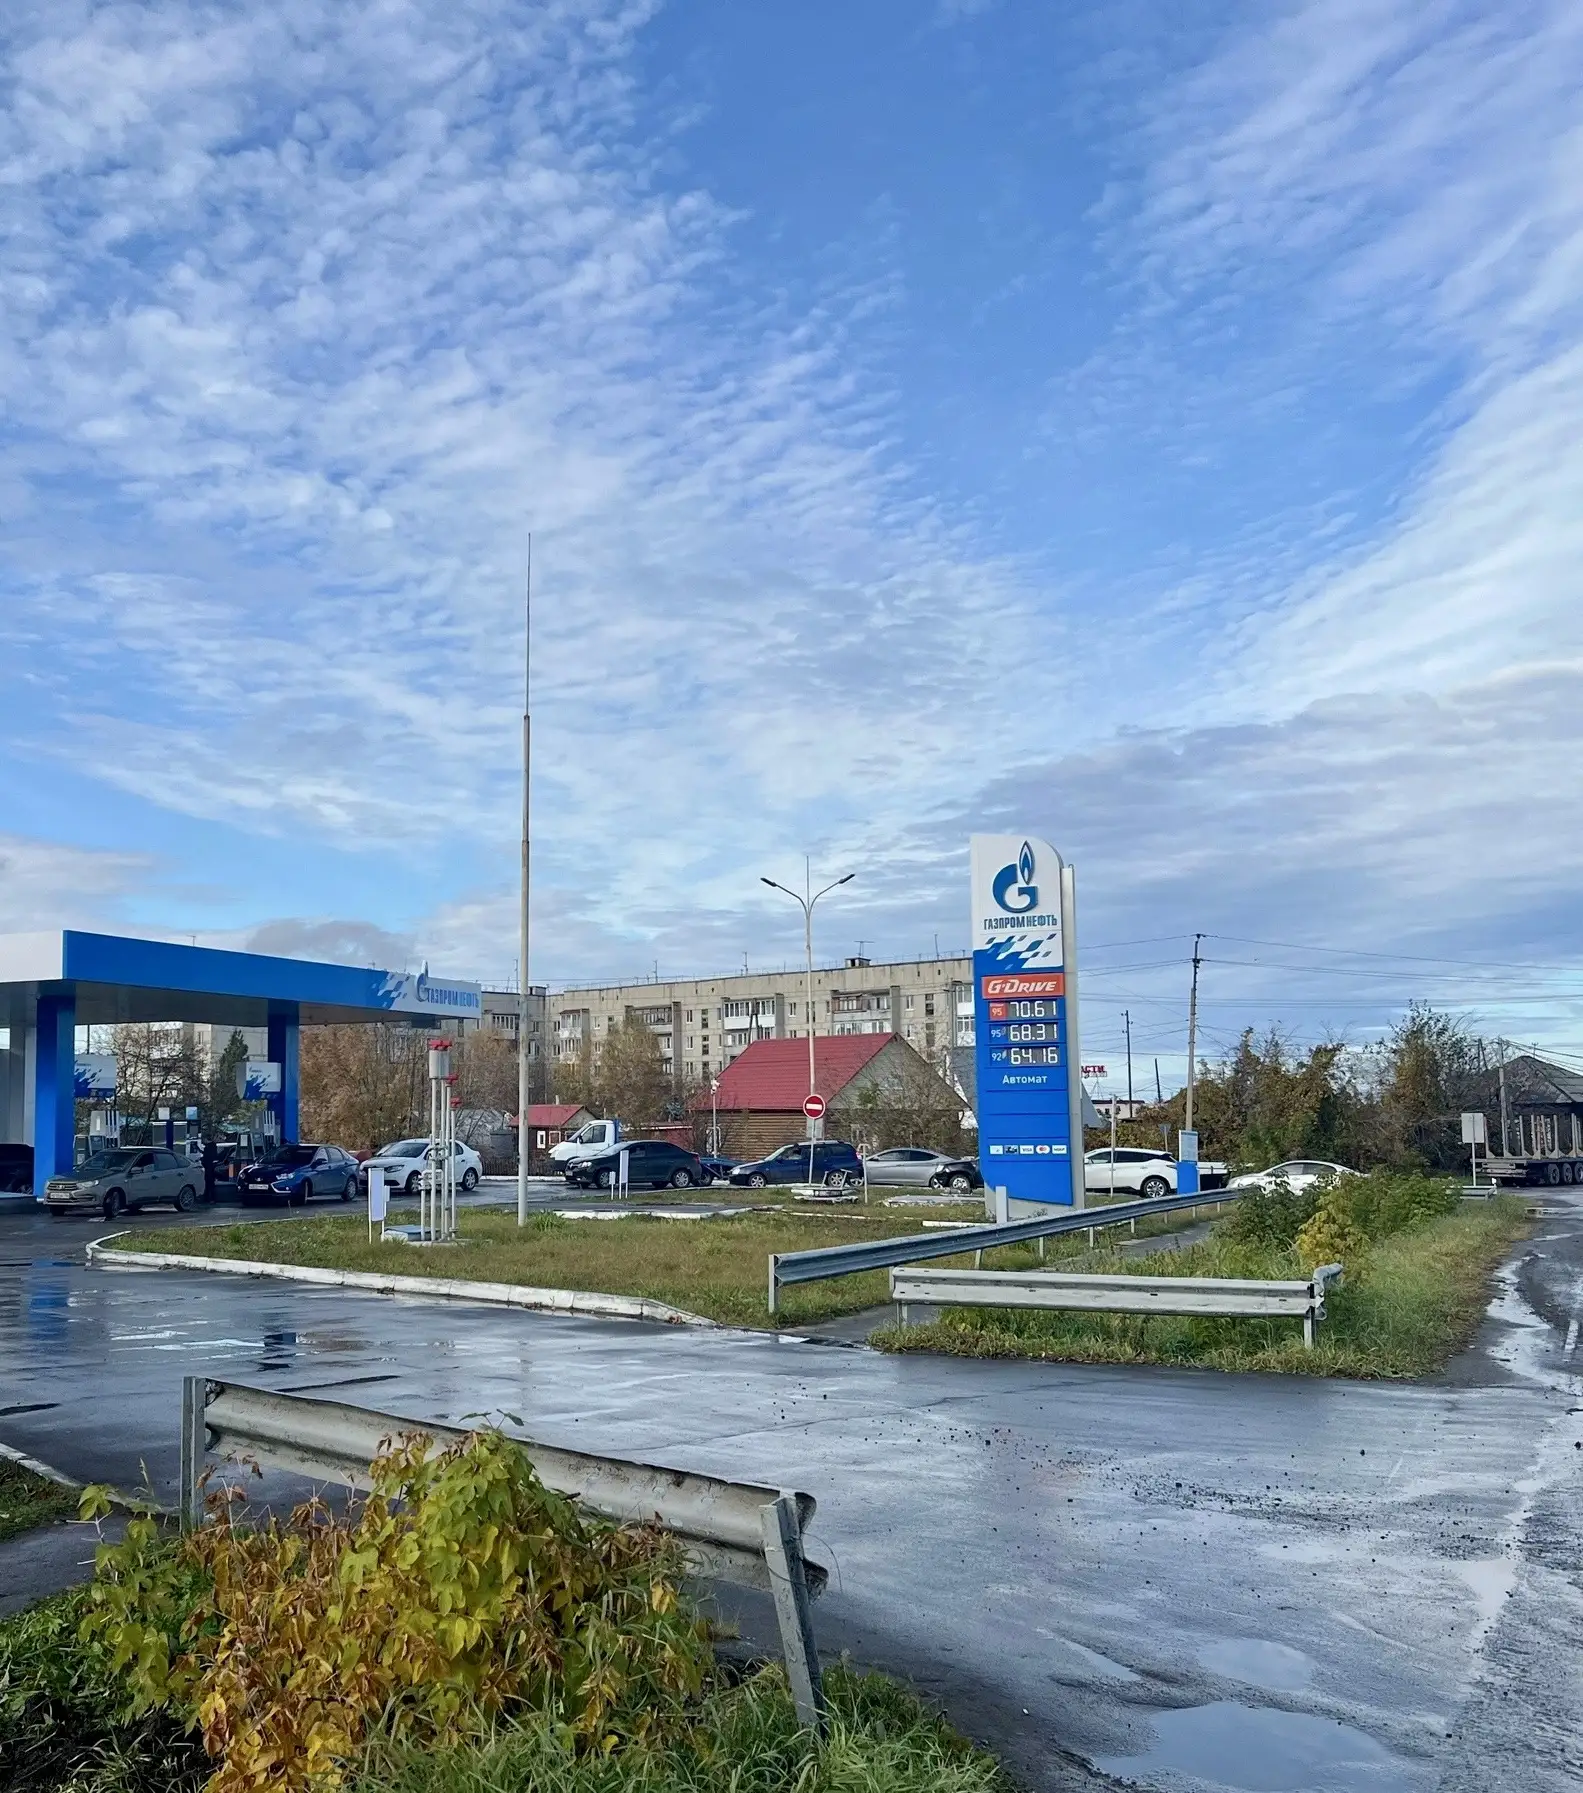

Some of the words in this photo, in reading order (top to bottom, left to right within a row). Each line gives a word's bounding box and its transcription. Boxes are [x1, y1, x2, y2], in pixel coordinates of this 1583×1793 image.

[991, 1007, 1003, 1017] 95
[1010, 1000, 1057, 1018] 70.61
[991, 1029, 1002, 1038] 95
[1010, 1023, 1058, 1042] 68.31
[991, 1052, 1003, 1061] 92
[1010, 1046, 1059, 1065] 64.16
[1002, 1075, 1048, 1085] Автомат
